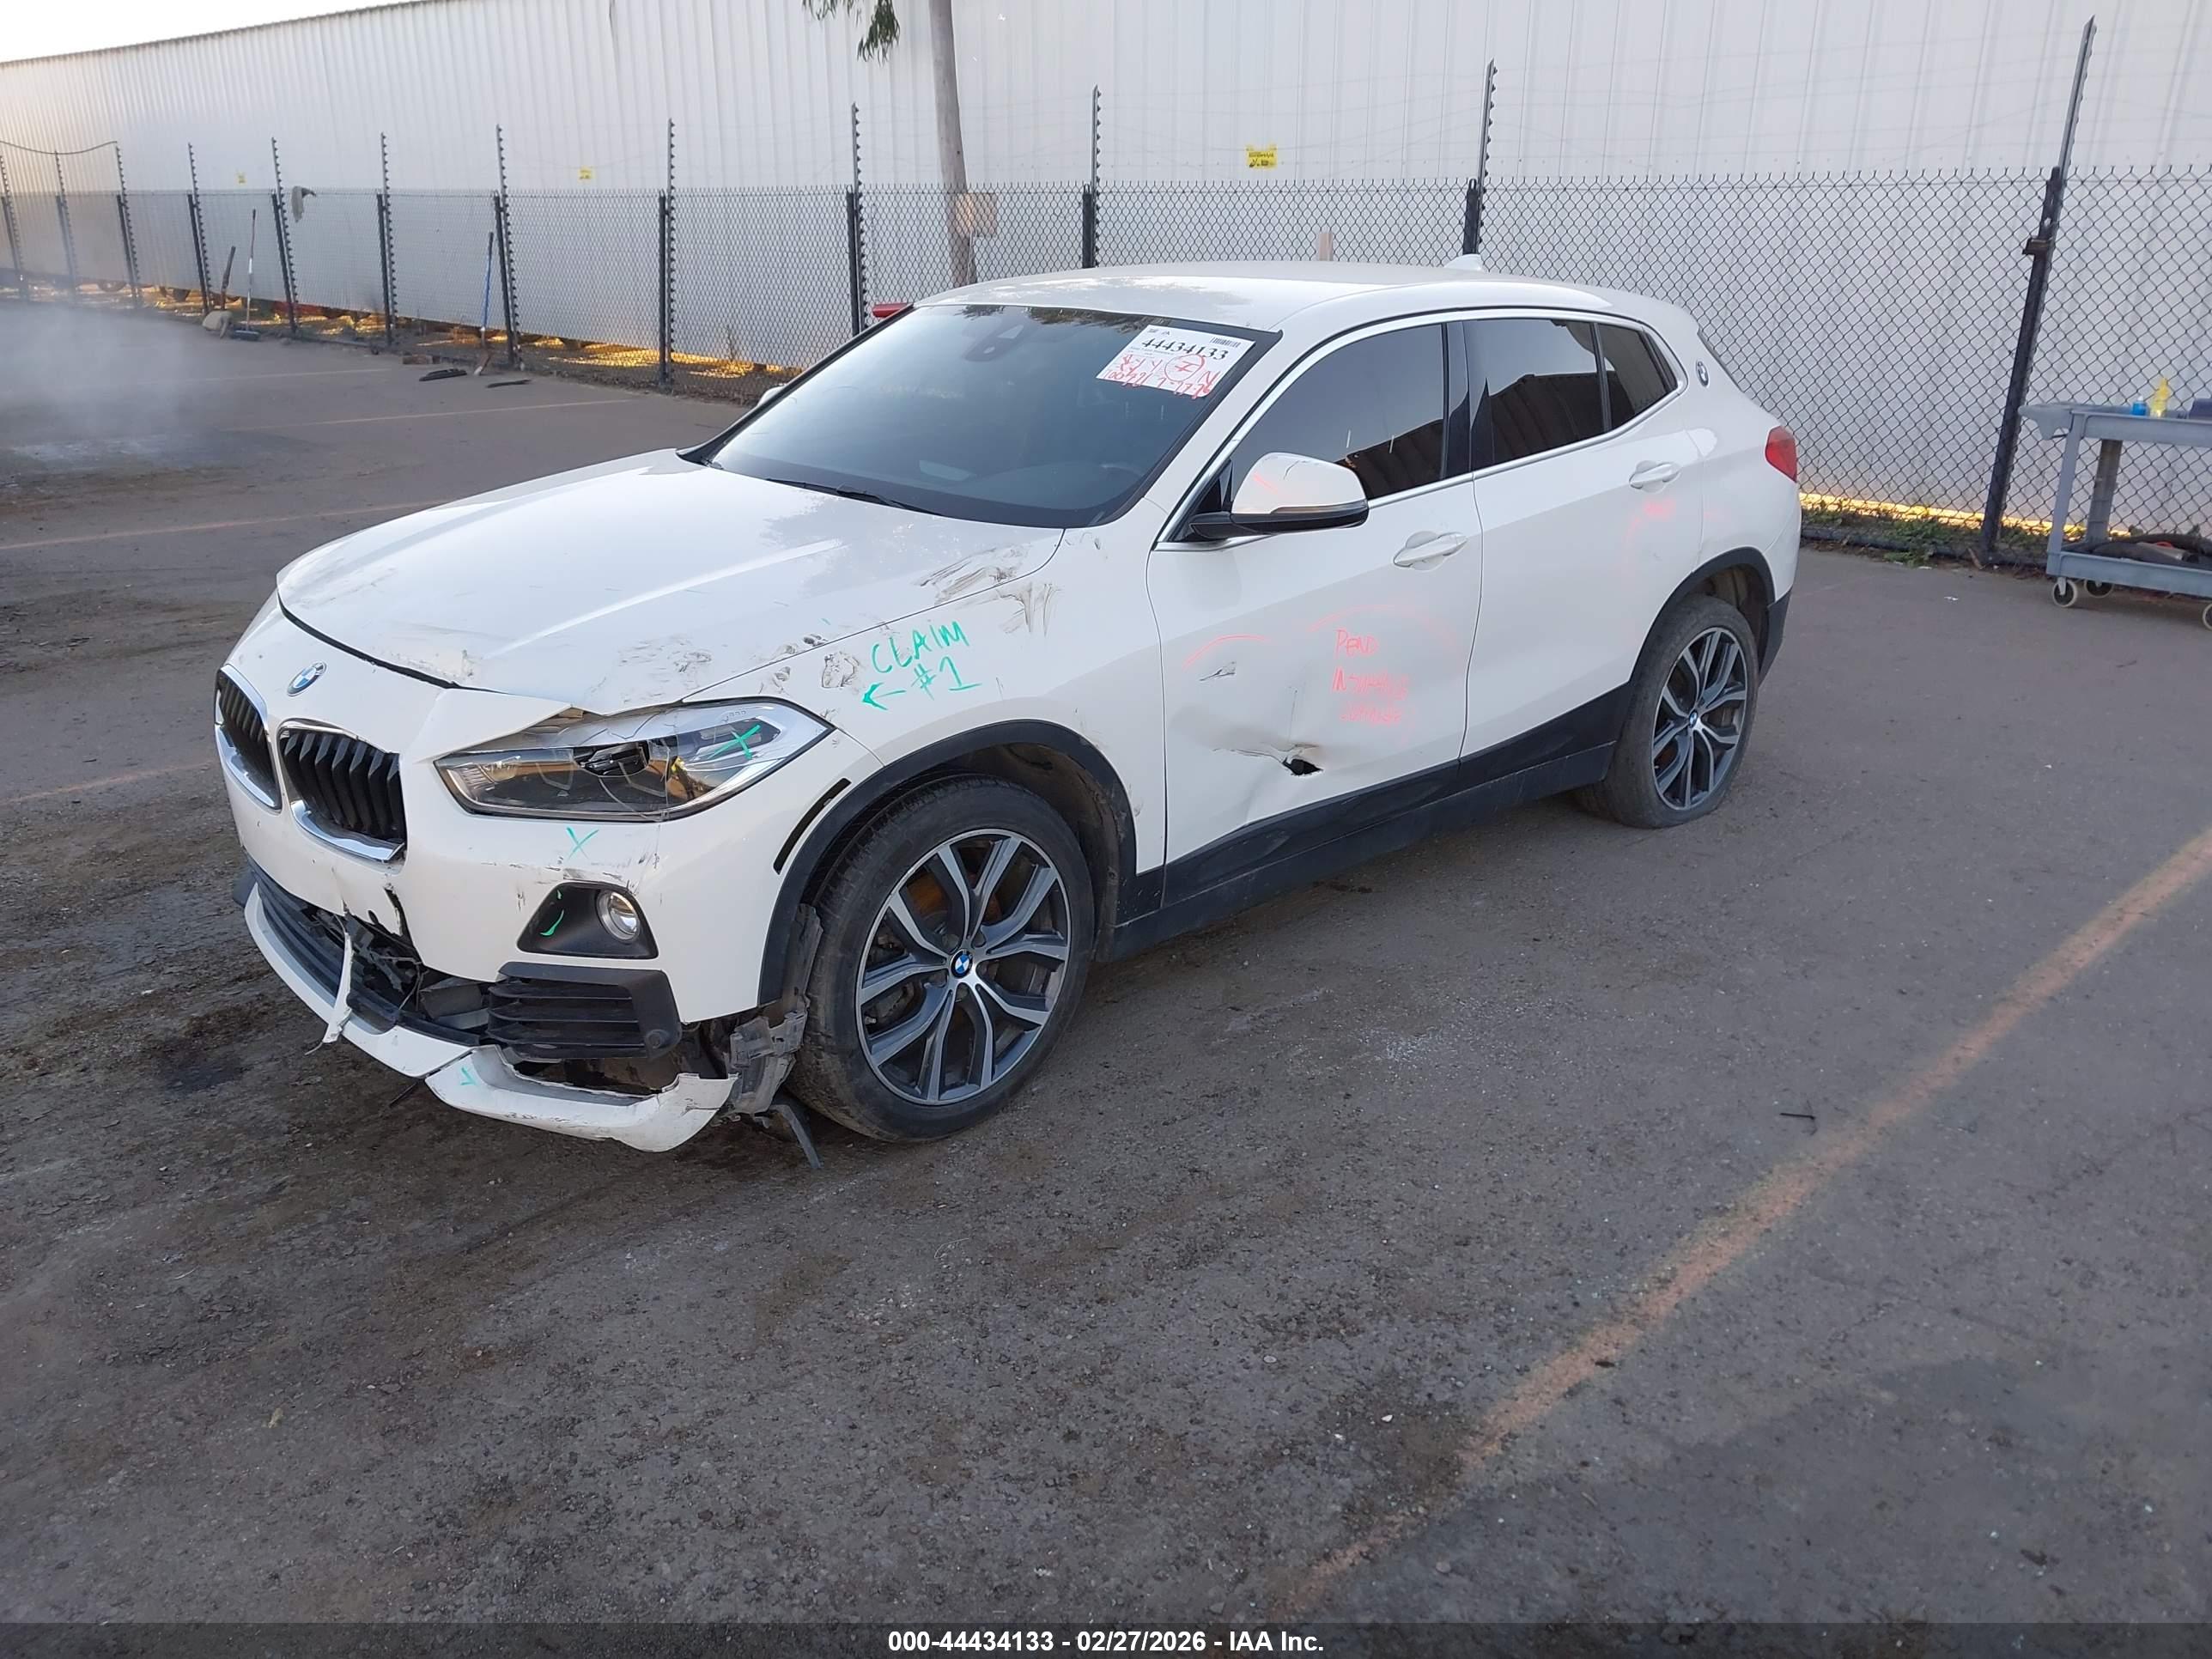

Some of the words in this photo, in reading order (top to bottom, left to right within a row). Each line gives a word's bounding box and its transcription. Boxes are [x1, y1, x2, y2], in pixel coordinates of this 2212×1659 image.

[1141, 337, 1229, 361] 44434133
[872, 621, 969, 673] CLAIM
[911, 656, 982, 701] #1
